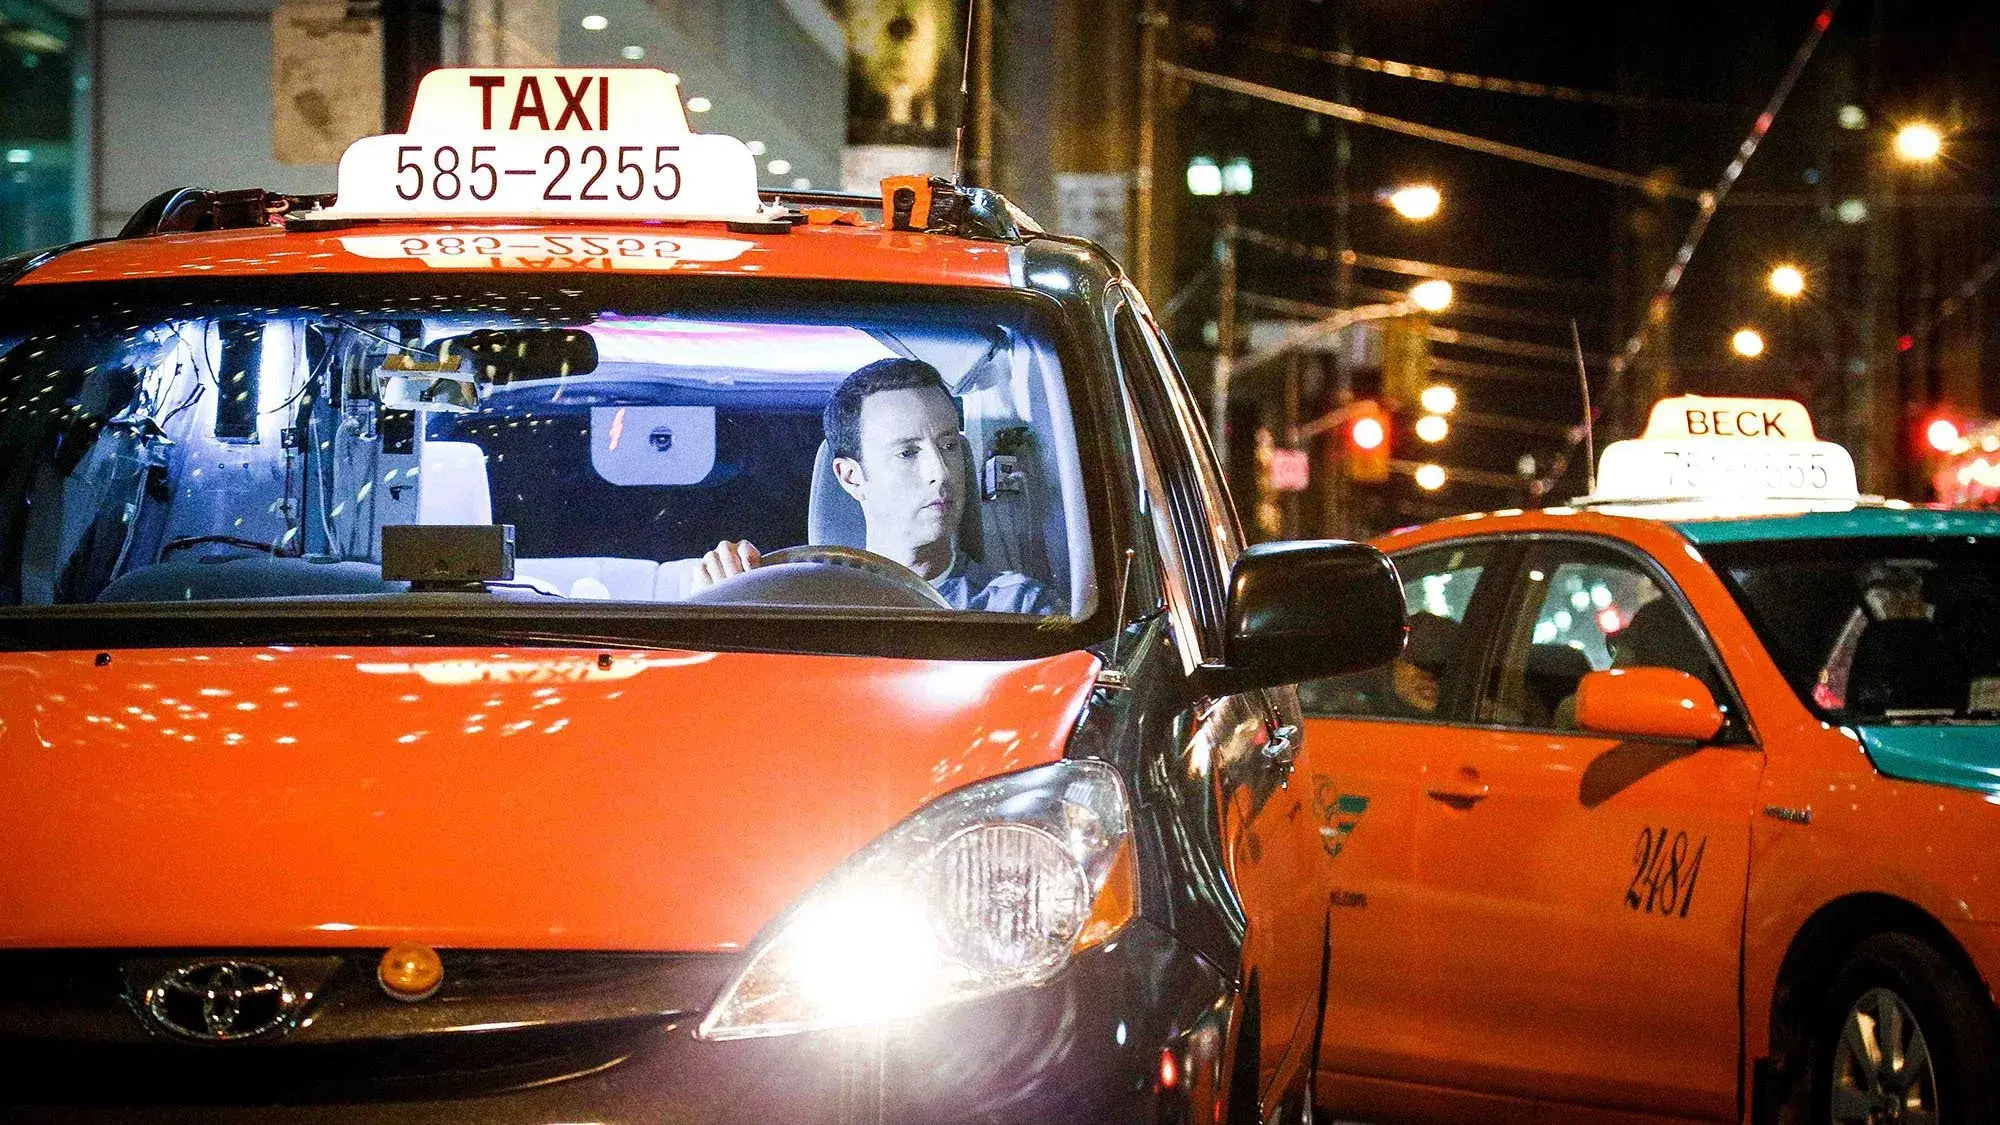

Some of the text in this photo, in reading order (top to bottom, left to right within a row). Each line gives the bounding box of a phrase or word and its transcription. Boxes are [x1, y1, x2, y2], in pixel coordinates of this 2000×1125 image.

[469, 76, 609, 131] TAXI
[395, 145, 681, 201] 585-2255
[1686, 410, 1786, 437] BECK
[1624, 827, 1707, 918] 2481
